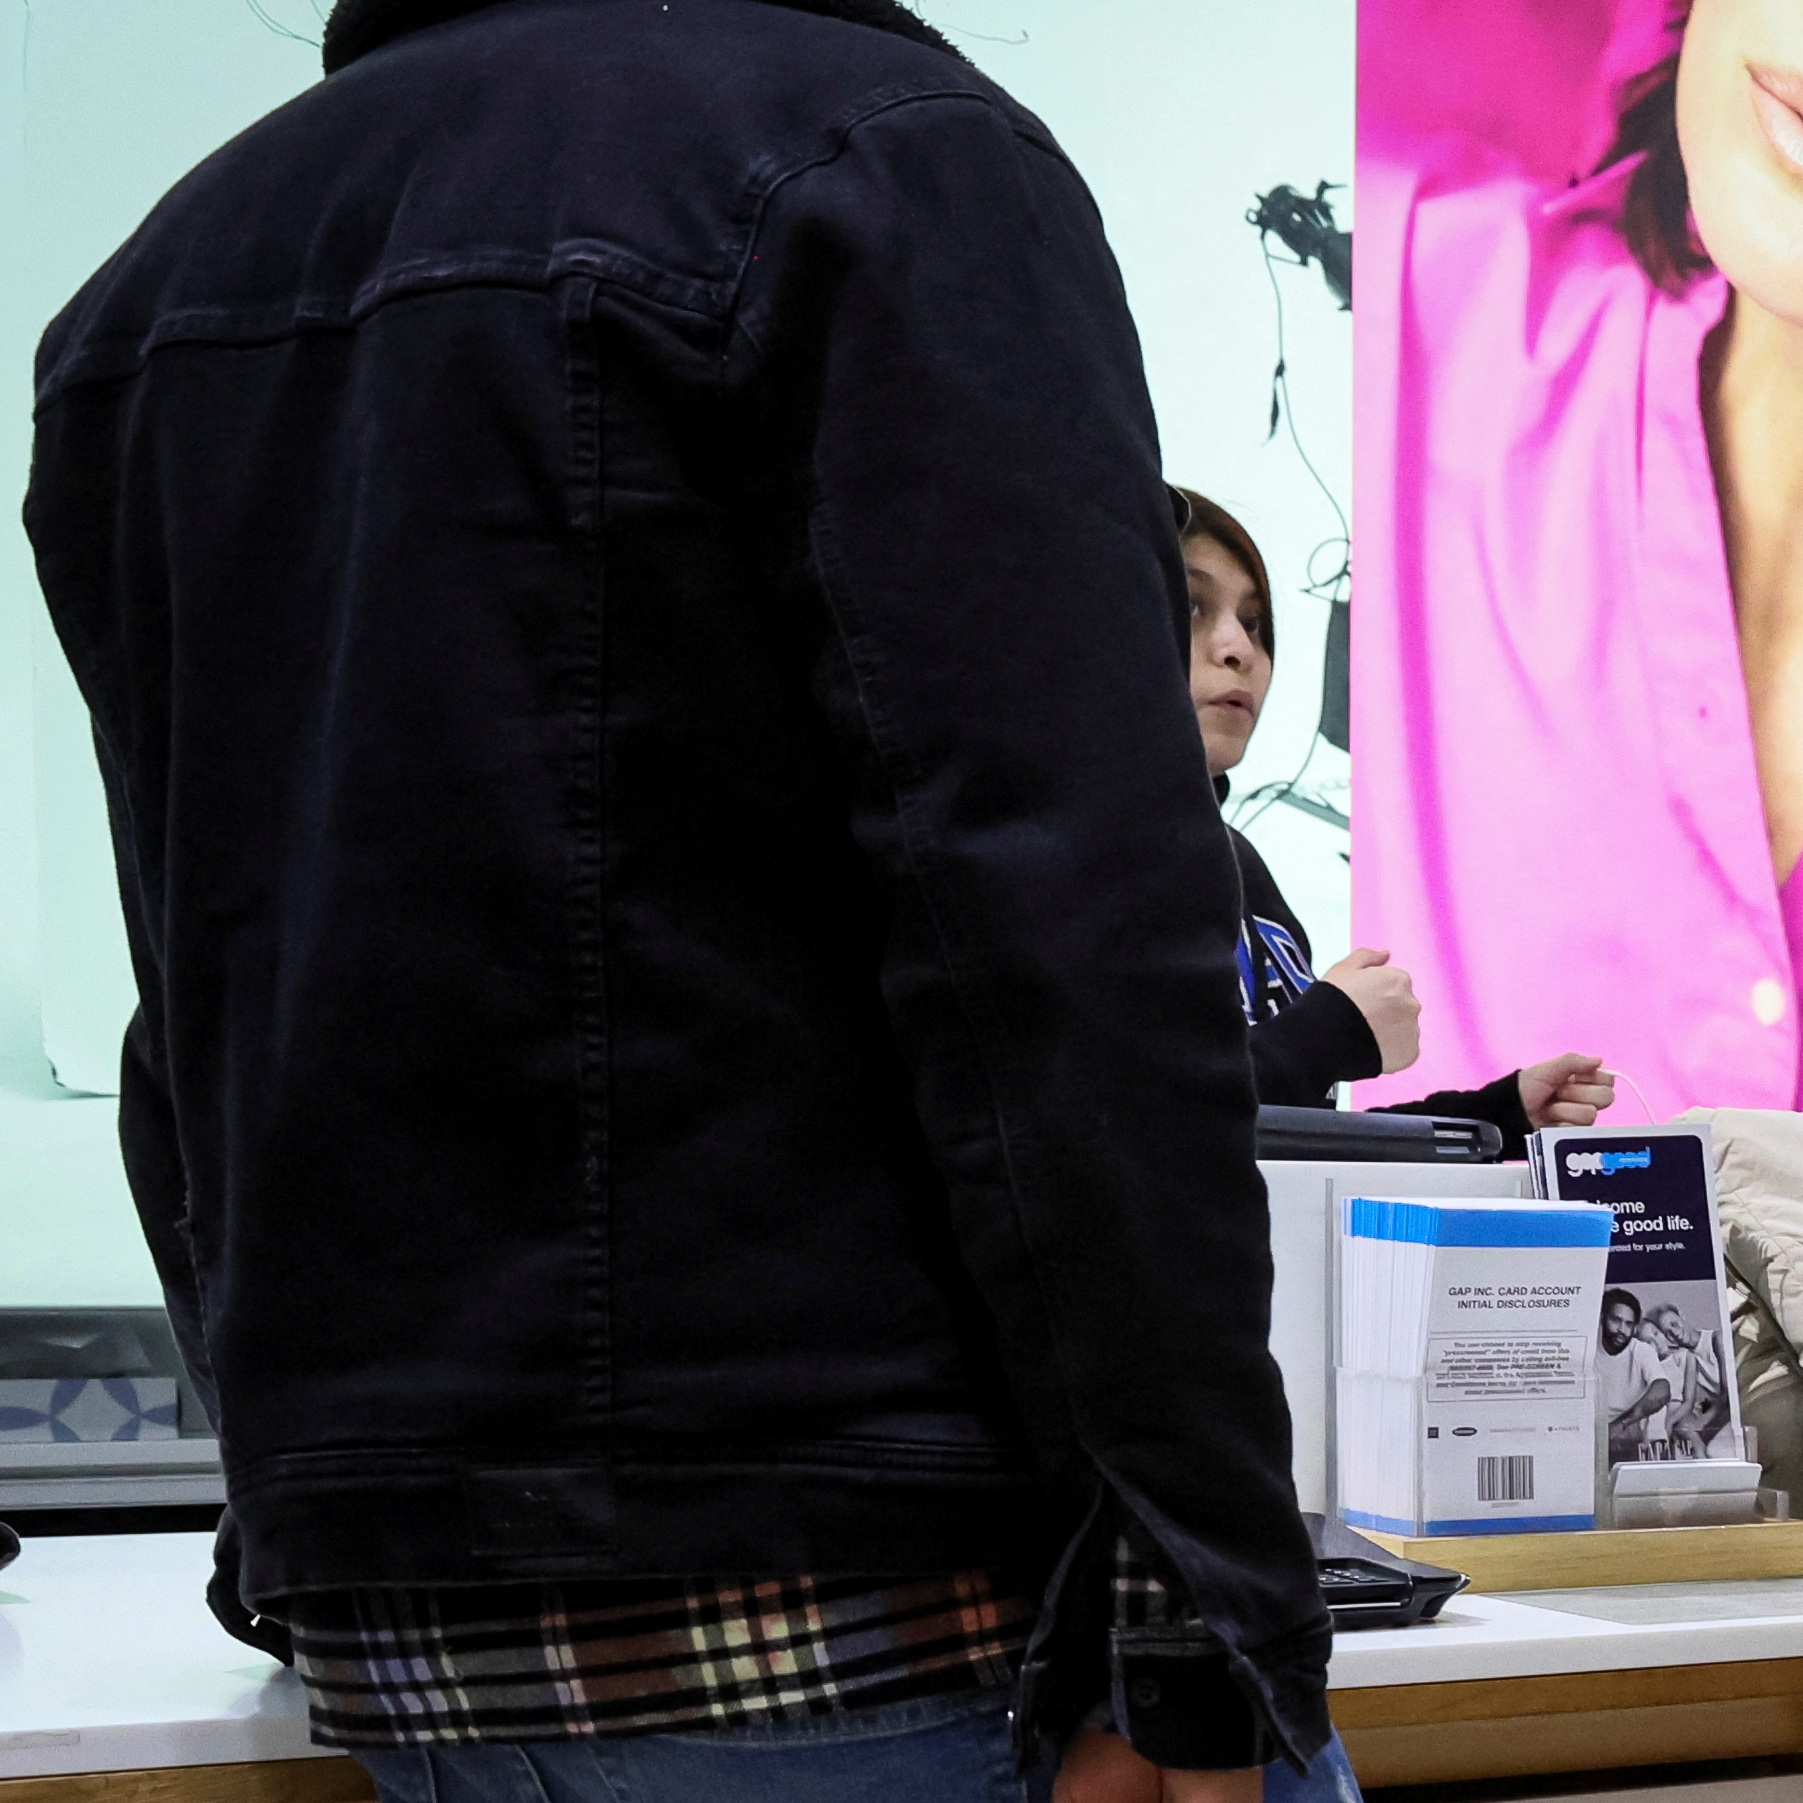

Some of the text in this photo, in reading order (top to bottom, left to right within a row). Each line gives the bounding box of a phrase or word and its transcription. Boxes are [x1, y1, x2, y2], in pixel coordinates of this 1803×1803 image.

[1623, 1215, 1664, 1236] good
[1666, 1215, 1694, 1231] life.
[1632, 1242, 1643, 1251] for
[1644, 1243, 1663, 1253] your
[1448, 1286, 1582, 1296] GAP INC. CARD ACCOUNT
[1457, 1299, 1570, 1309] INITIAL DISCLOSURES
